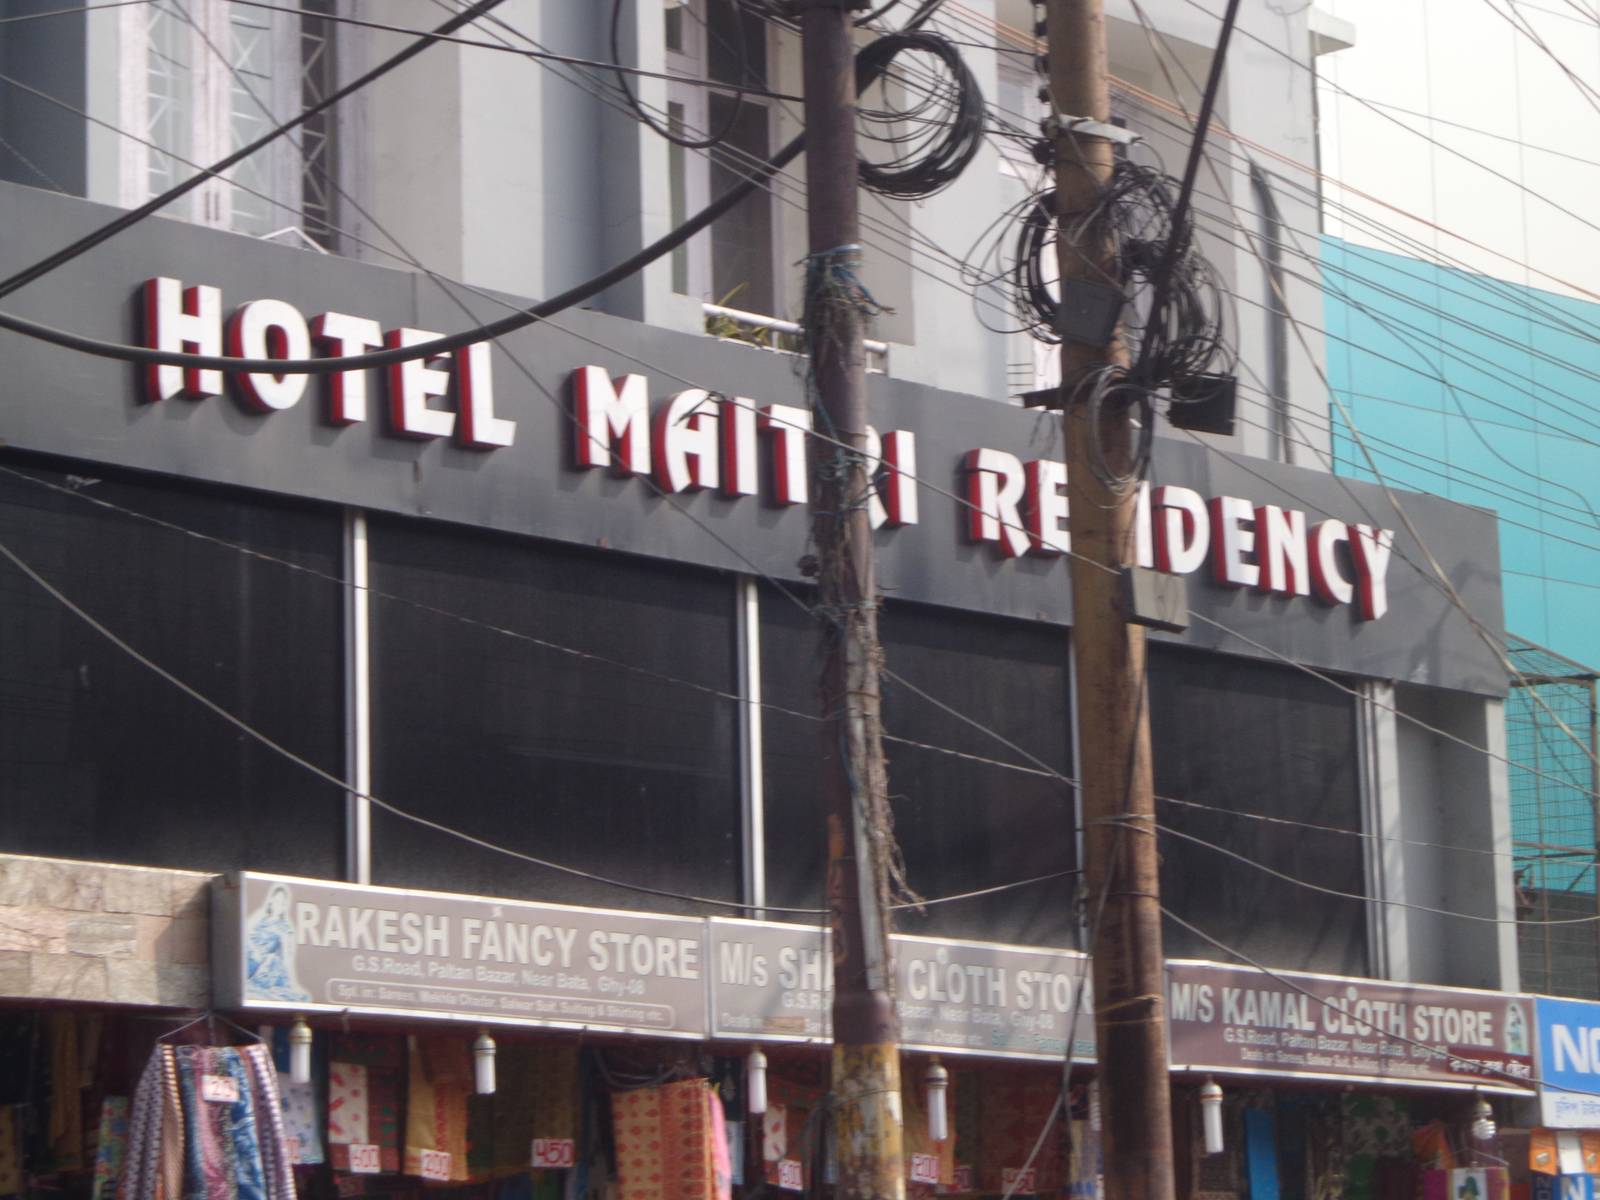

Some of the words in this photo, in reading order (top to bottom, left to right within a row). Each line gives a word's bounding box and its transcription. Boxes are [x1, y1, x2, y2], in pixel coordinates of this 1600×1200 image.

[145, 277, 516, 448] HOTEL
[965, 448, 1395, 621] REIDENCY
[296, 902, 450, 957] RAKESH
[463, 918, 579, 968] FANCY
[588, 930, 699, 979] STORE
[720, 941, 769, 987] M/s
[907, 959, 1007, 1008] CLOTH
[1171, 982, 1216, 1023] M/S
[1222, 987, 1316, 1032] KAMAL
[1322, 996, 1406, 1040] CLOTH
[1413, 1006, 1493, 1047] STORE
[536, 1138, 574, 1165] 450
